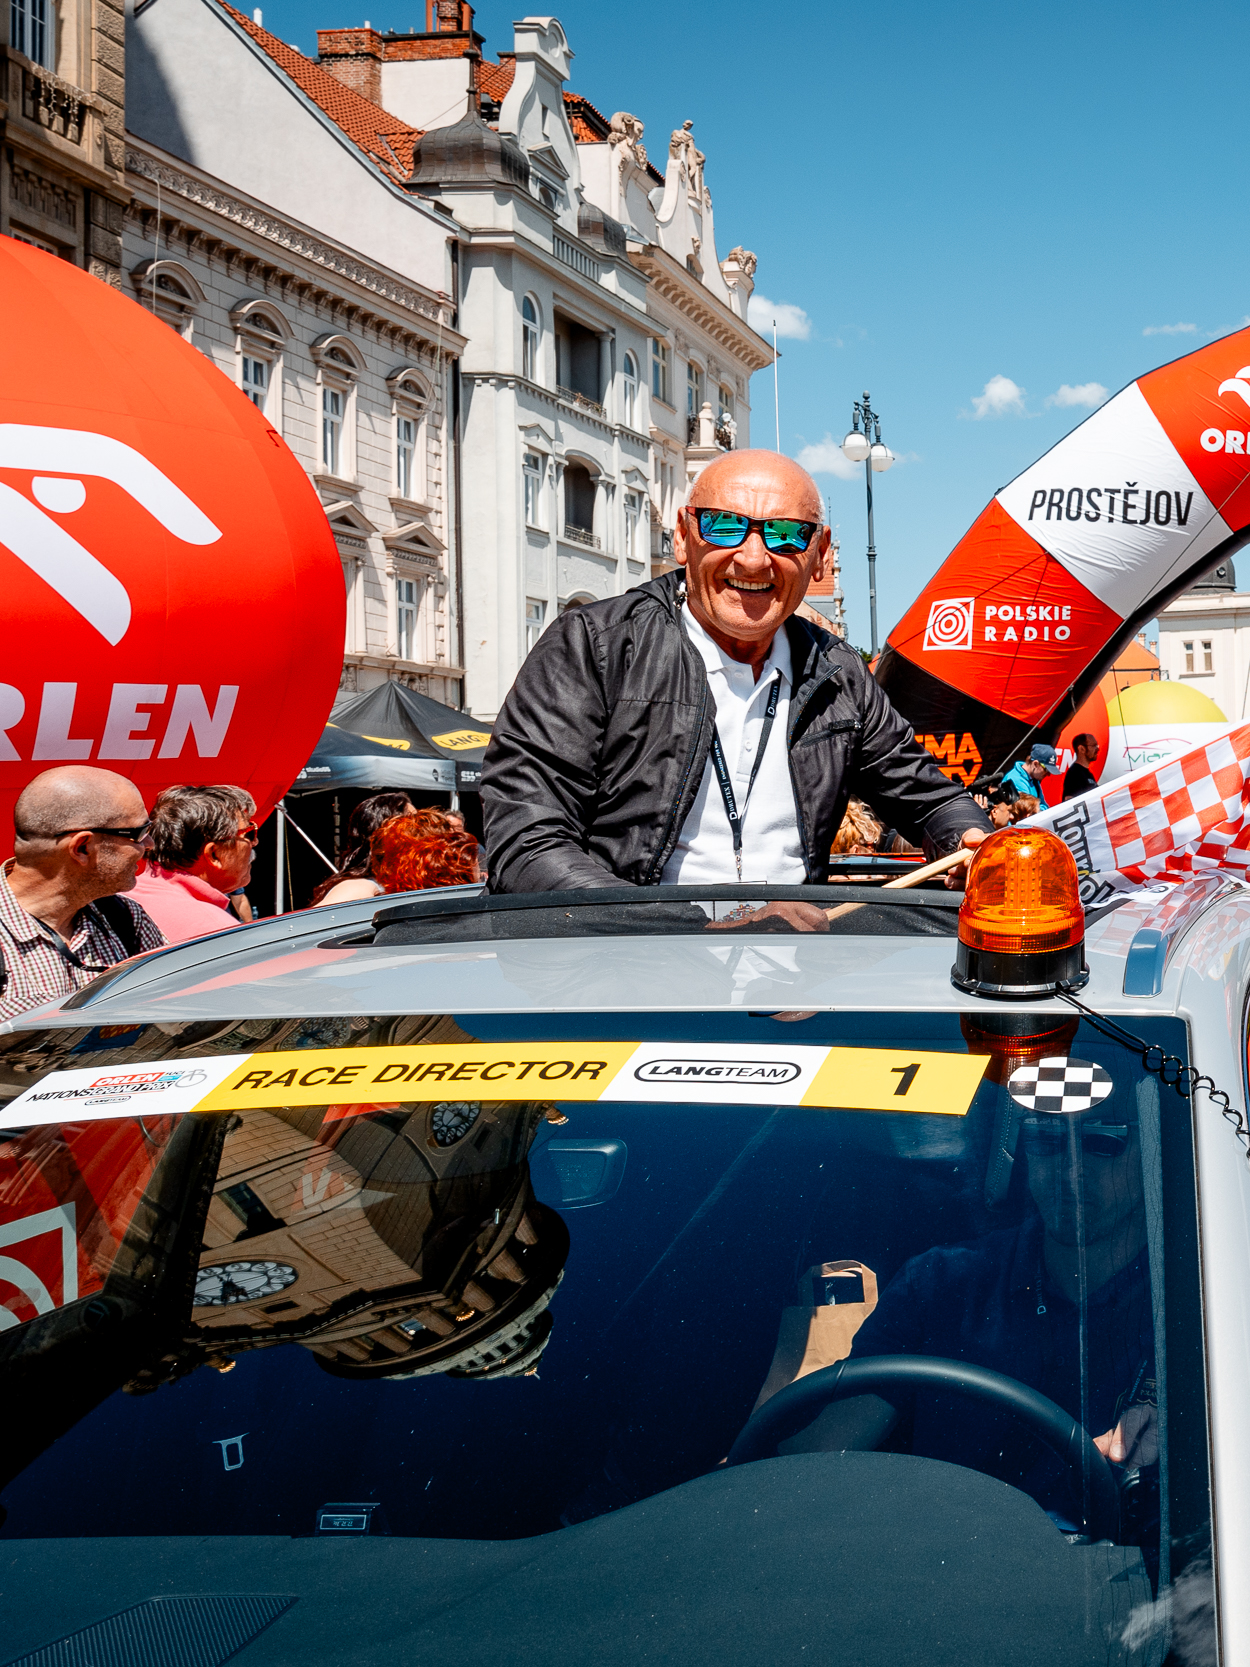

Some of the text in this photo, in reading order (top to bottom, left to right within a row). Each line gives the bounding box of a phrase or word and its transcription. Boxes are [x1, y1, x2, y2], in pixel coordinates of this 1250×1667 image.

[1028, 481, 1194, 526] PROSTĚJOV
[985, 605, 1072, 621] POLSKIE
[985, 626, 1072, 642] RADIO
[95, 1073, 160, 1086] ORLEN
[233, 1060, 608, 1091] RACE DIRECTOR
[649, 1065, 789, 1079] LANGTEAM
[890, 1063, 922, 1096] 1
[26, 1088, 94, 1102] NATIONS
